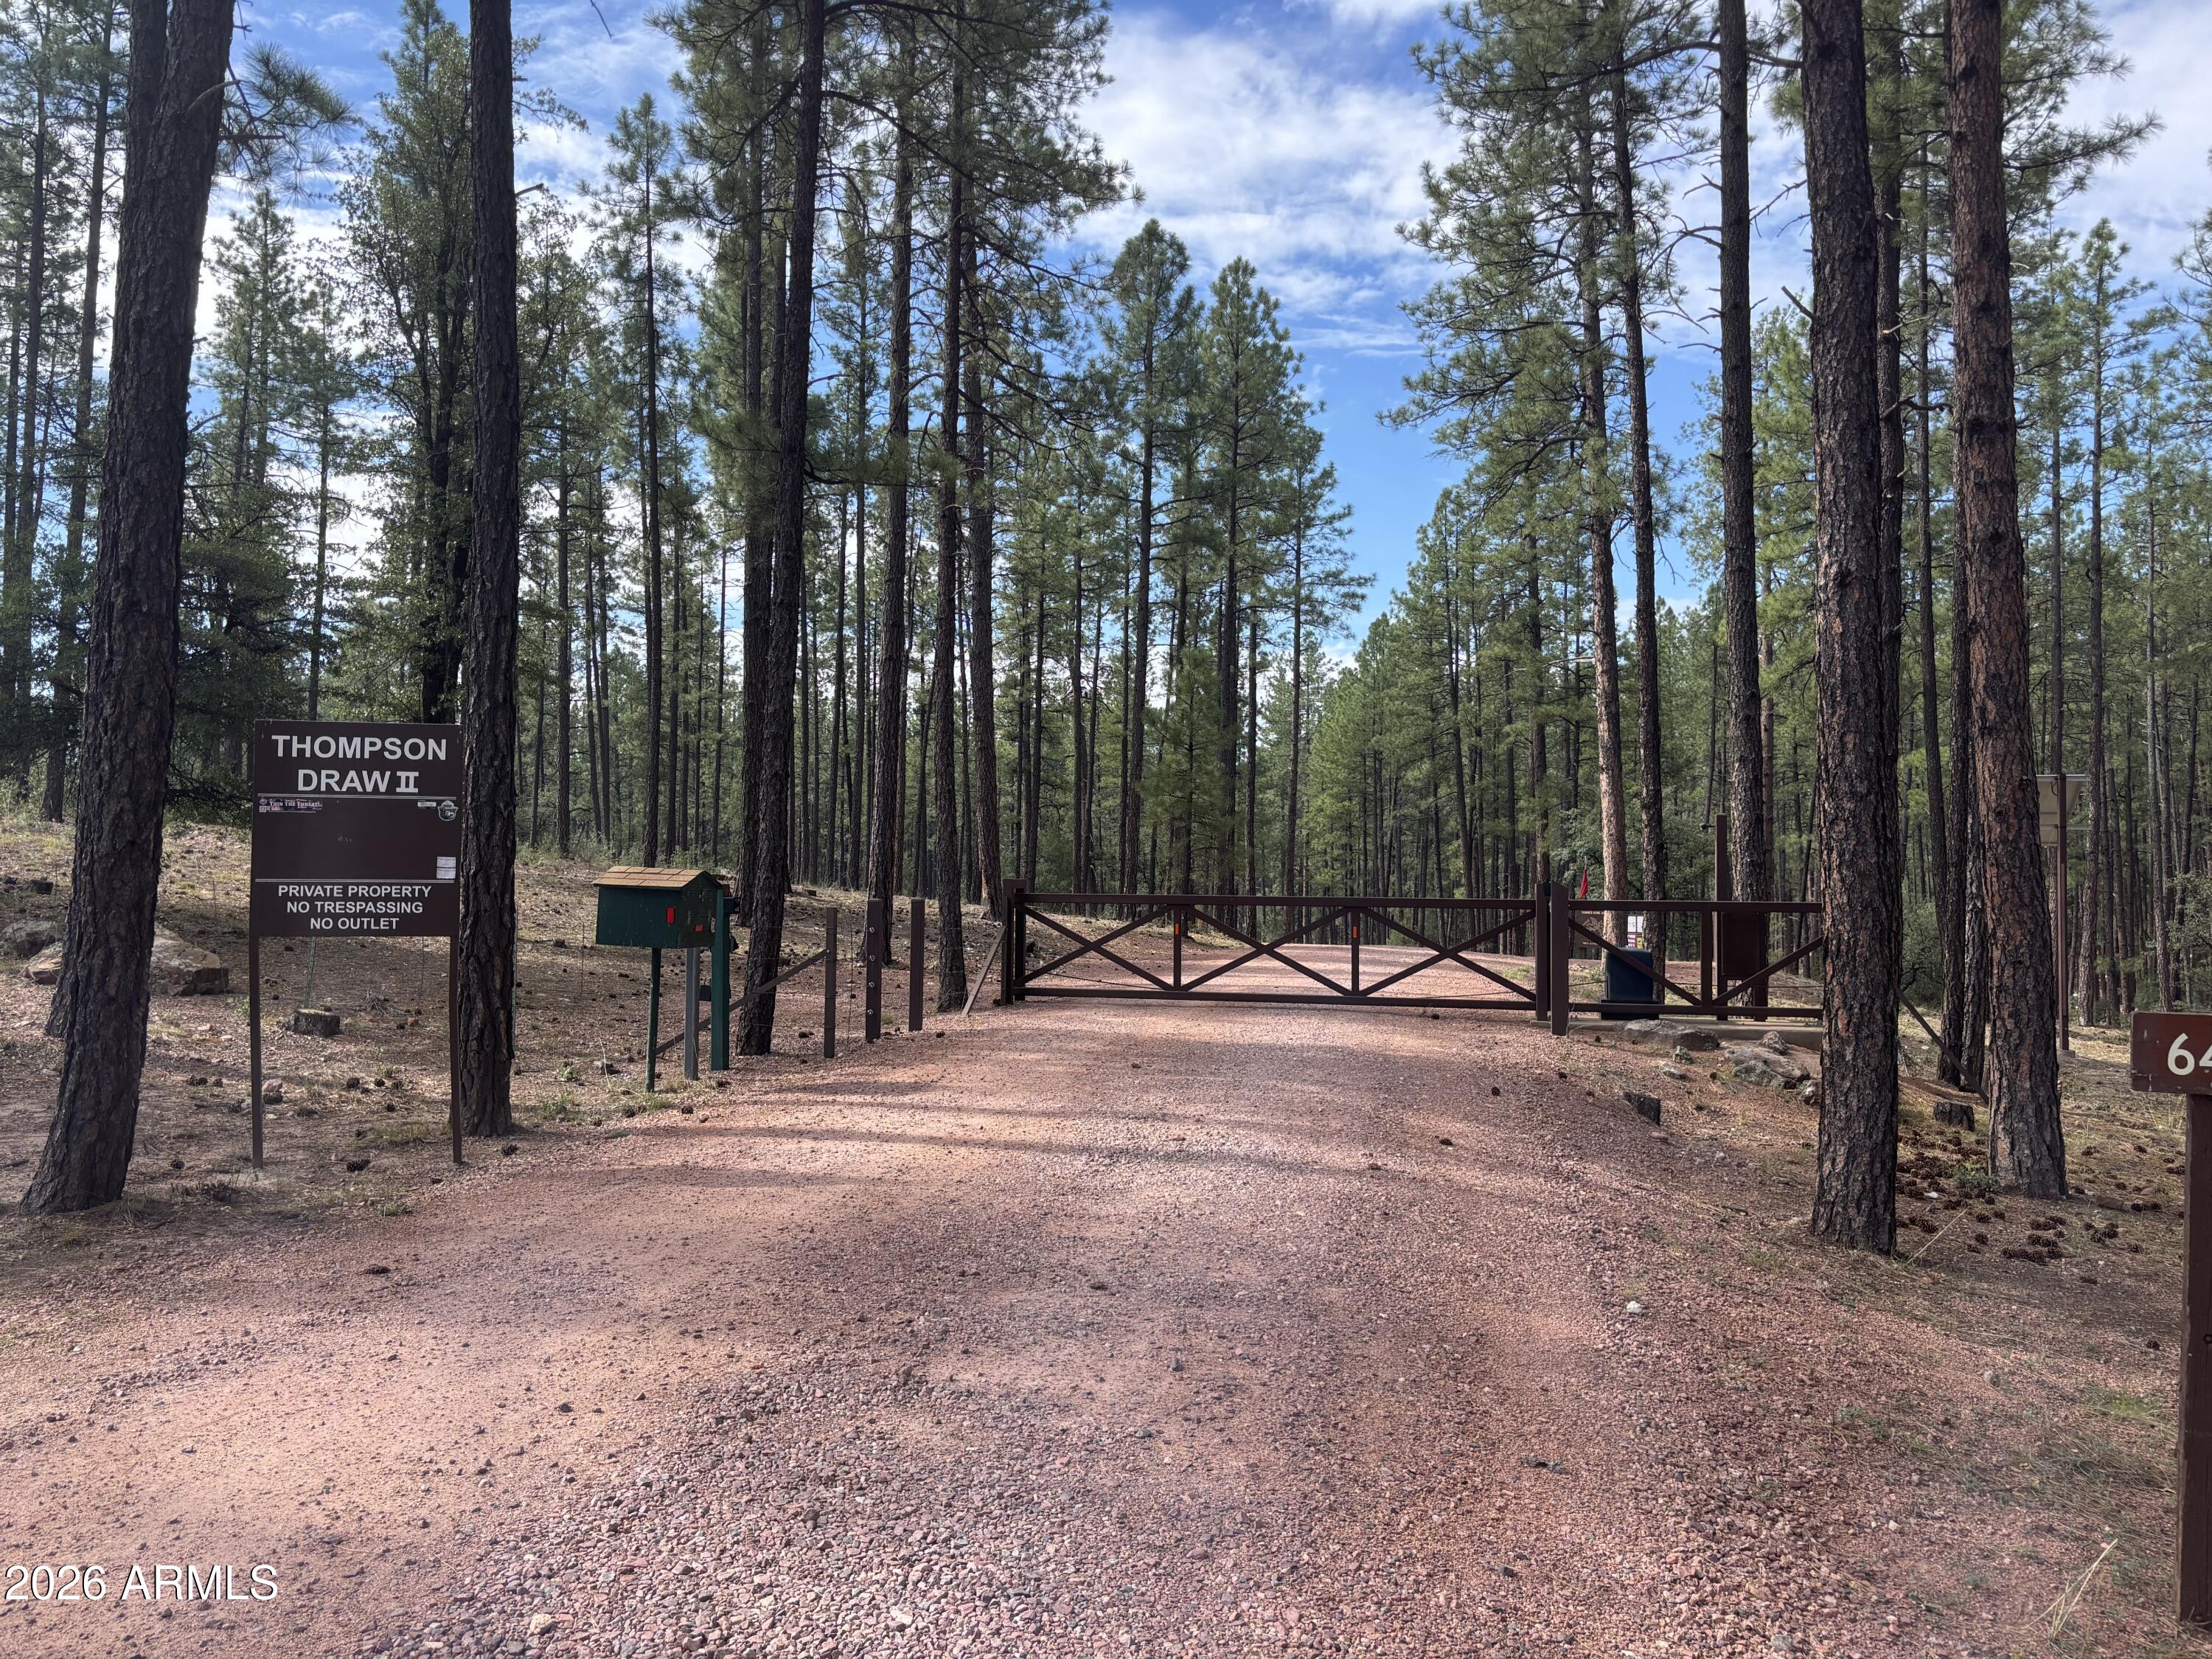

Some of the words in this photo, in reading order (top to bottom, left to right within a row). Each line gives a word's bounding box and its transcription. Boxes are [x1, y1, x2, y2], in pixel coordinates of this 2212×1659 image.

[271, 734, 447, 761] THOMPSON
[297, 769, 390, 793] DRAW
[395, 771, 420, 794] II
[278, 885, 344, 897] PRIVATE
[348, 885, 432, 897] PROPERTY
[287, 901, 310, 914] NO
[314, 901, 423, 914] TRESPASSING
[310, 917, 333, 930] NO
[338, 917, 400, 930] OUTLET
